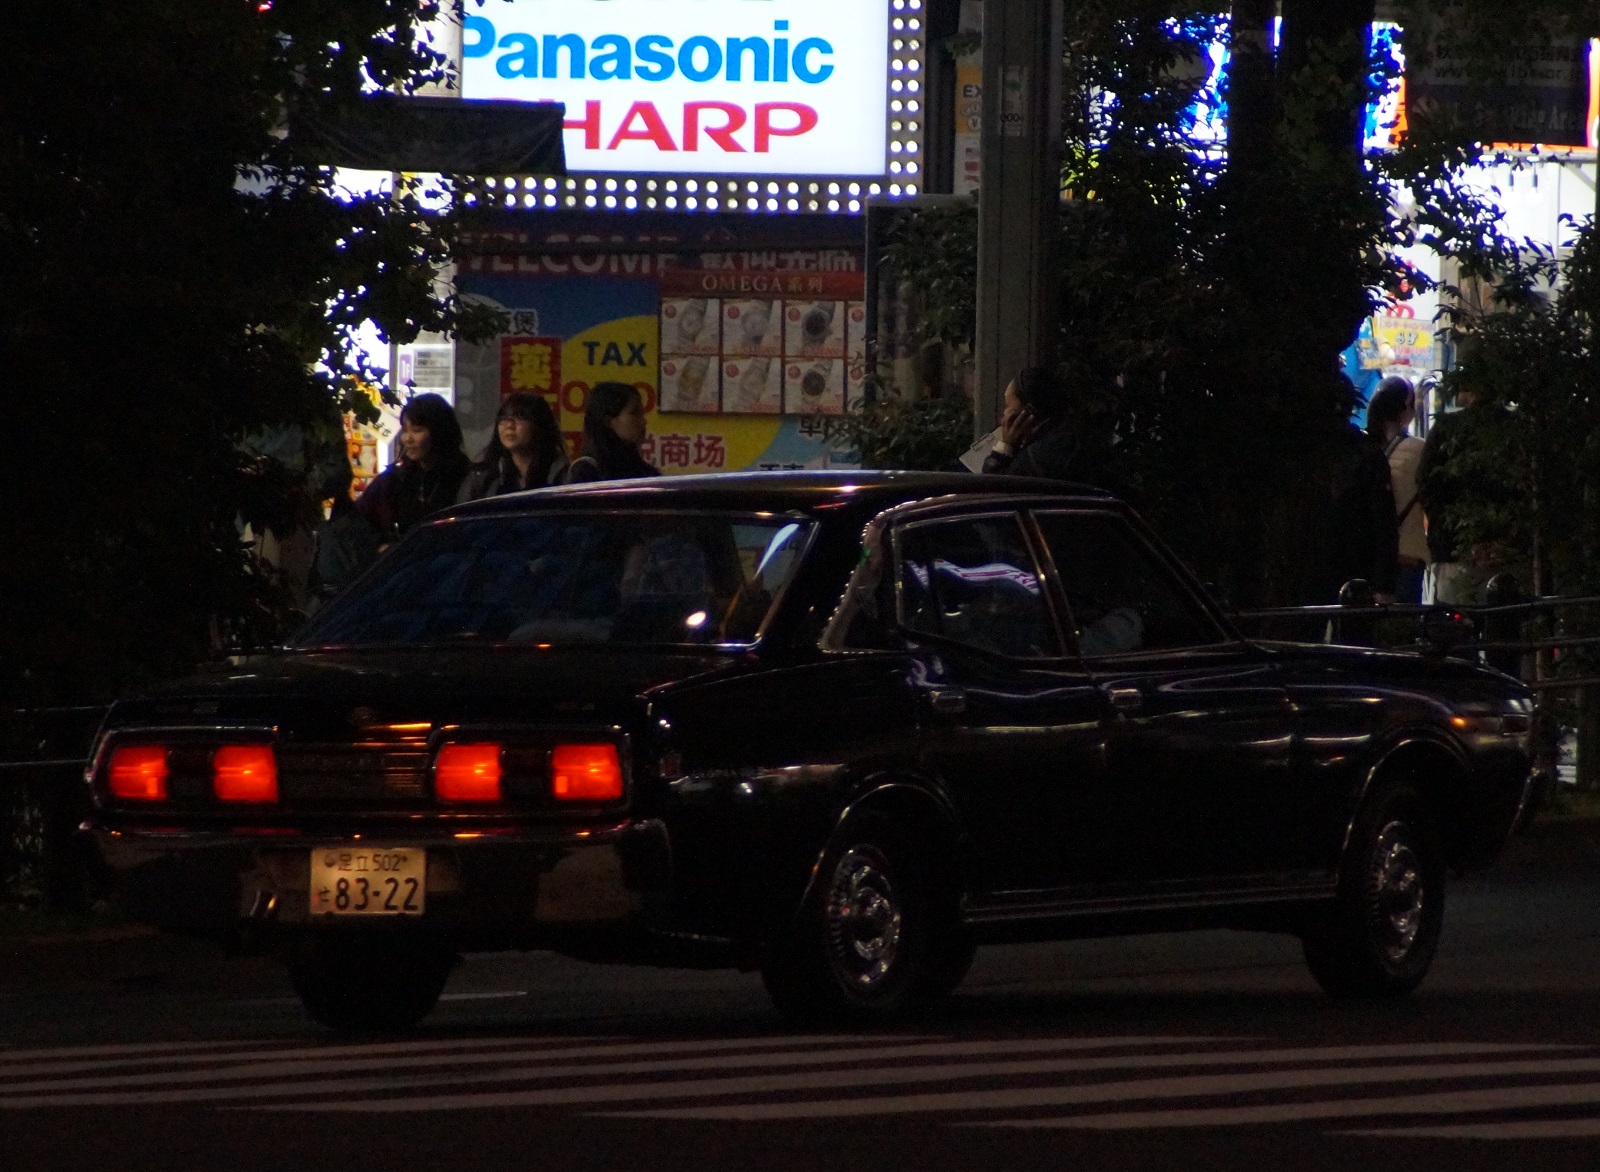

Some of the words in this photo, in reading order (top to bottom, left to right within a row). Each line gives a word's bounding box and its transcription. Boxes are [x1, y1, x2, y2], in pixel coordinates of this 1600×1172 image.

[463, 15, 834, 84] Panasonic
[555, 99, 819, 153] HARP
[702, 274, 782, 293] OMEGA
[583, 341, 648, 367] TAX
[373, 853, 400, 872] 502
[335, 877, 419, 910] 83-22
